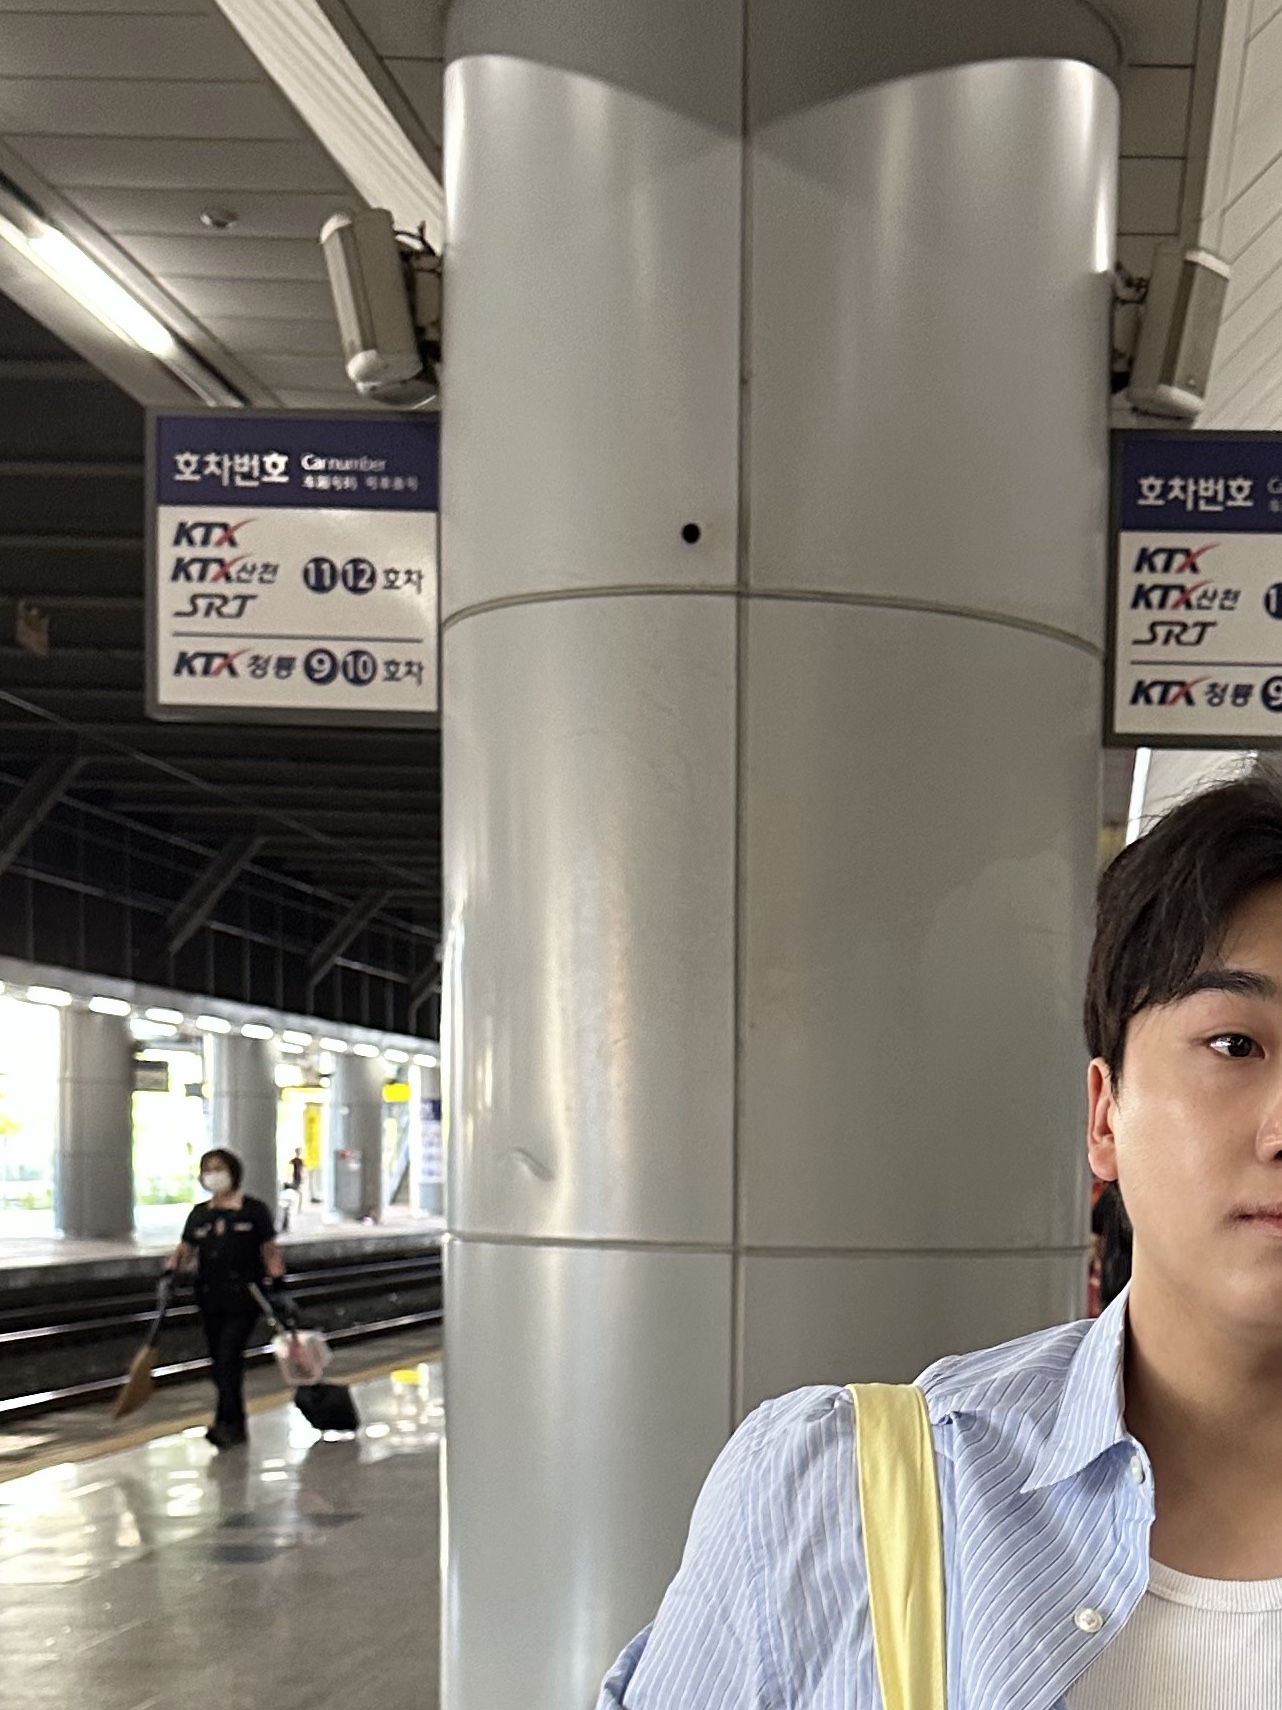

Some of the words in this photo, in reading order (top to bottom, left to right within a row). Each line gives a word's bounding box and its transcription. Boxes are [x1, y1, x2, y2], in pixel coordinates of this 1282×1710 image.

[173, 450, 290, 488] 호차번호
[301, 452, 326, 470] Car
[1136, 476, 1254, 512] 호차번호
[173, 518, 256, 548] KTX
[1133, 542, 1220, 574] KTX
[305, 560, 334, 589] 11
[343, 560, 375, 590] 12
[382, 566, 424, 595] 호차
[173, 593, 258, 618] SRT
[1132, 621, 1218, 646] SRT
[173, 649, 254, 678] KTX
[307, 652, 333, 683] 9
[344, 653, 375, 682] 10
[382, 658, 424, 686] 호차
[1130, 675, 1211, 706] KTX
